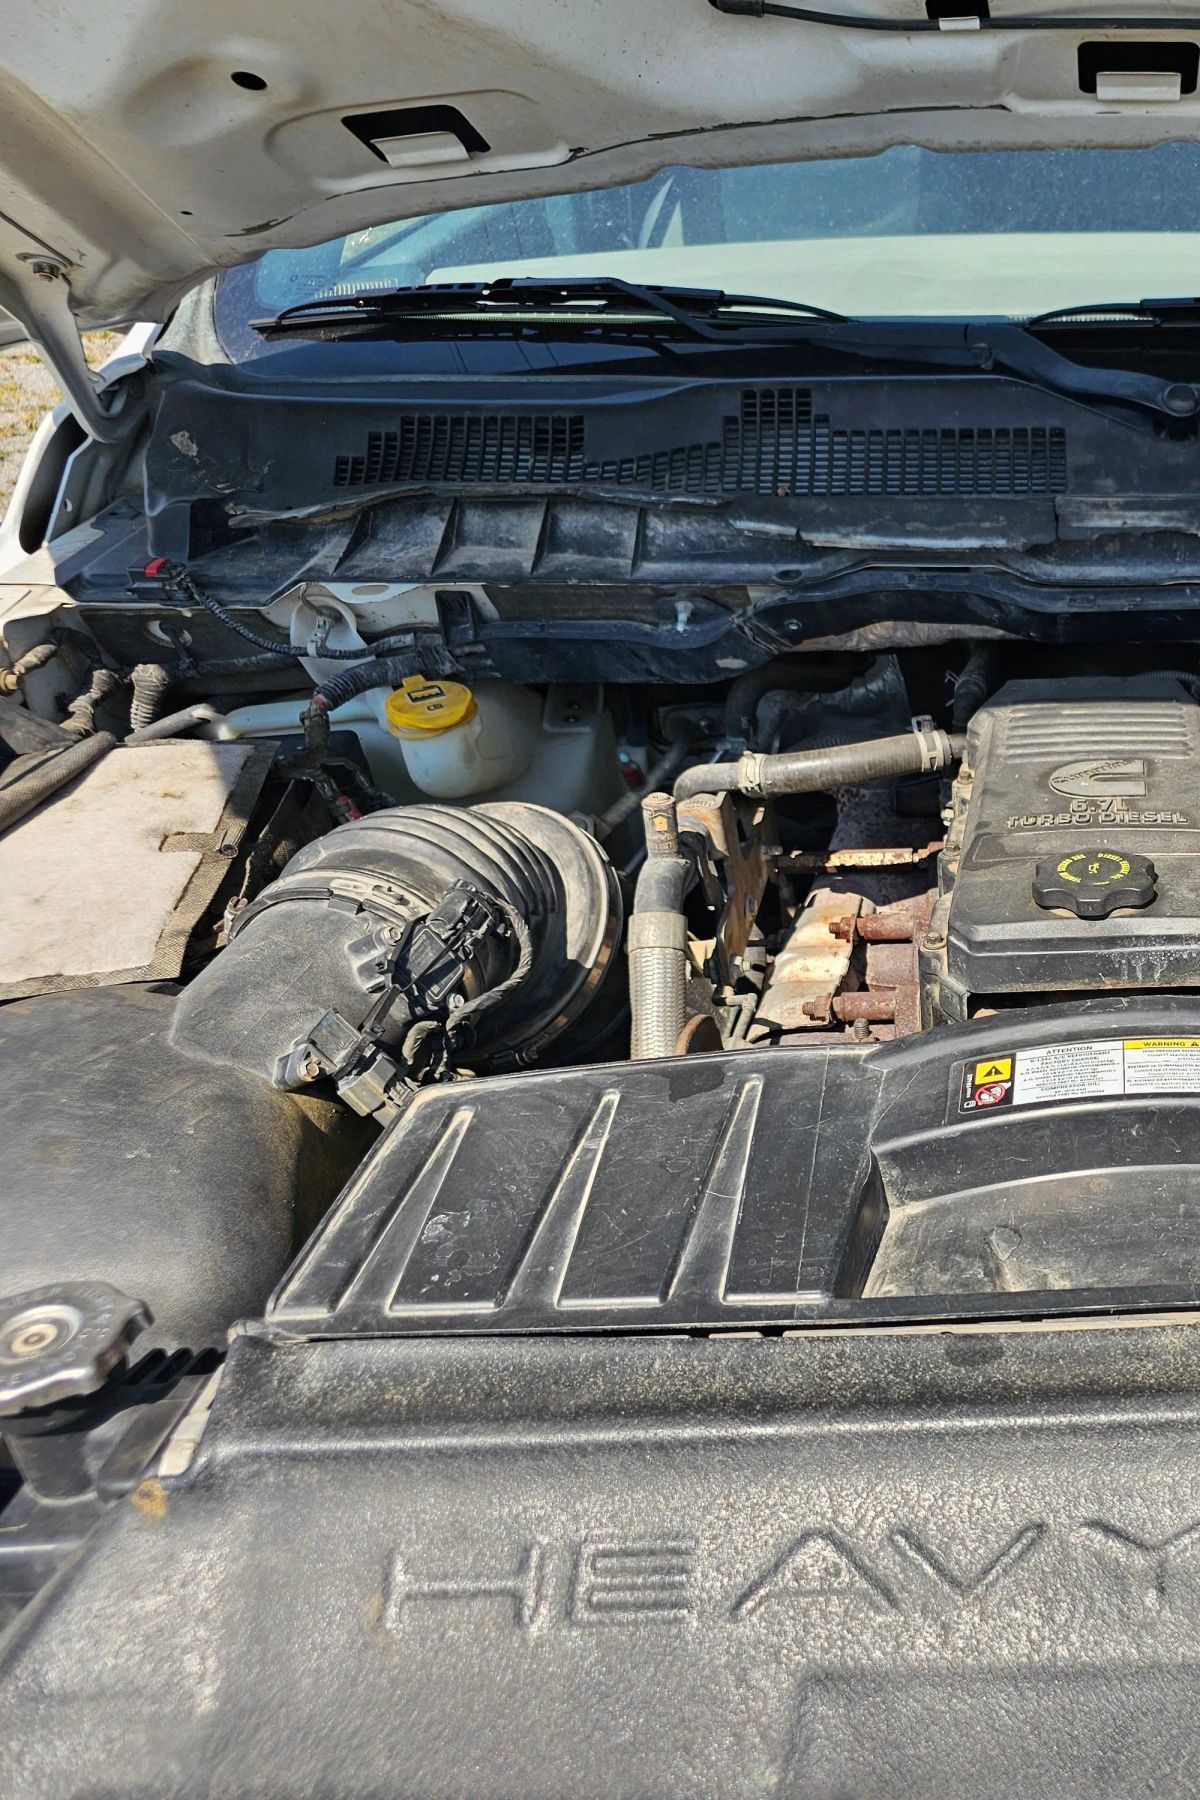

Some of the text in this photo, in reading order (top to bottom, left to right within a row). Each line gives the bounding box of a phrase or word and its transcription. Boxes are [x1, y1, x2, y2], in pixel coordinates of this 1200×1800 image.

[1070, 799, 1130, 814] 6.7L
[1007, 810, 1190, 829] TURBO DIESEL
[1046, 1045, 1093, 1055] ATTENTION
